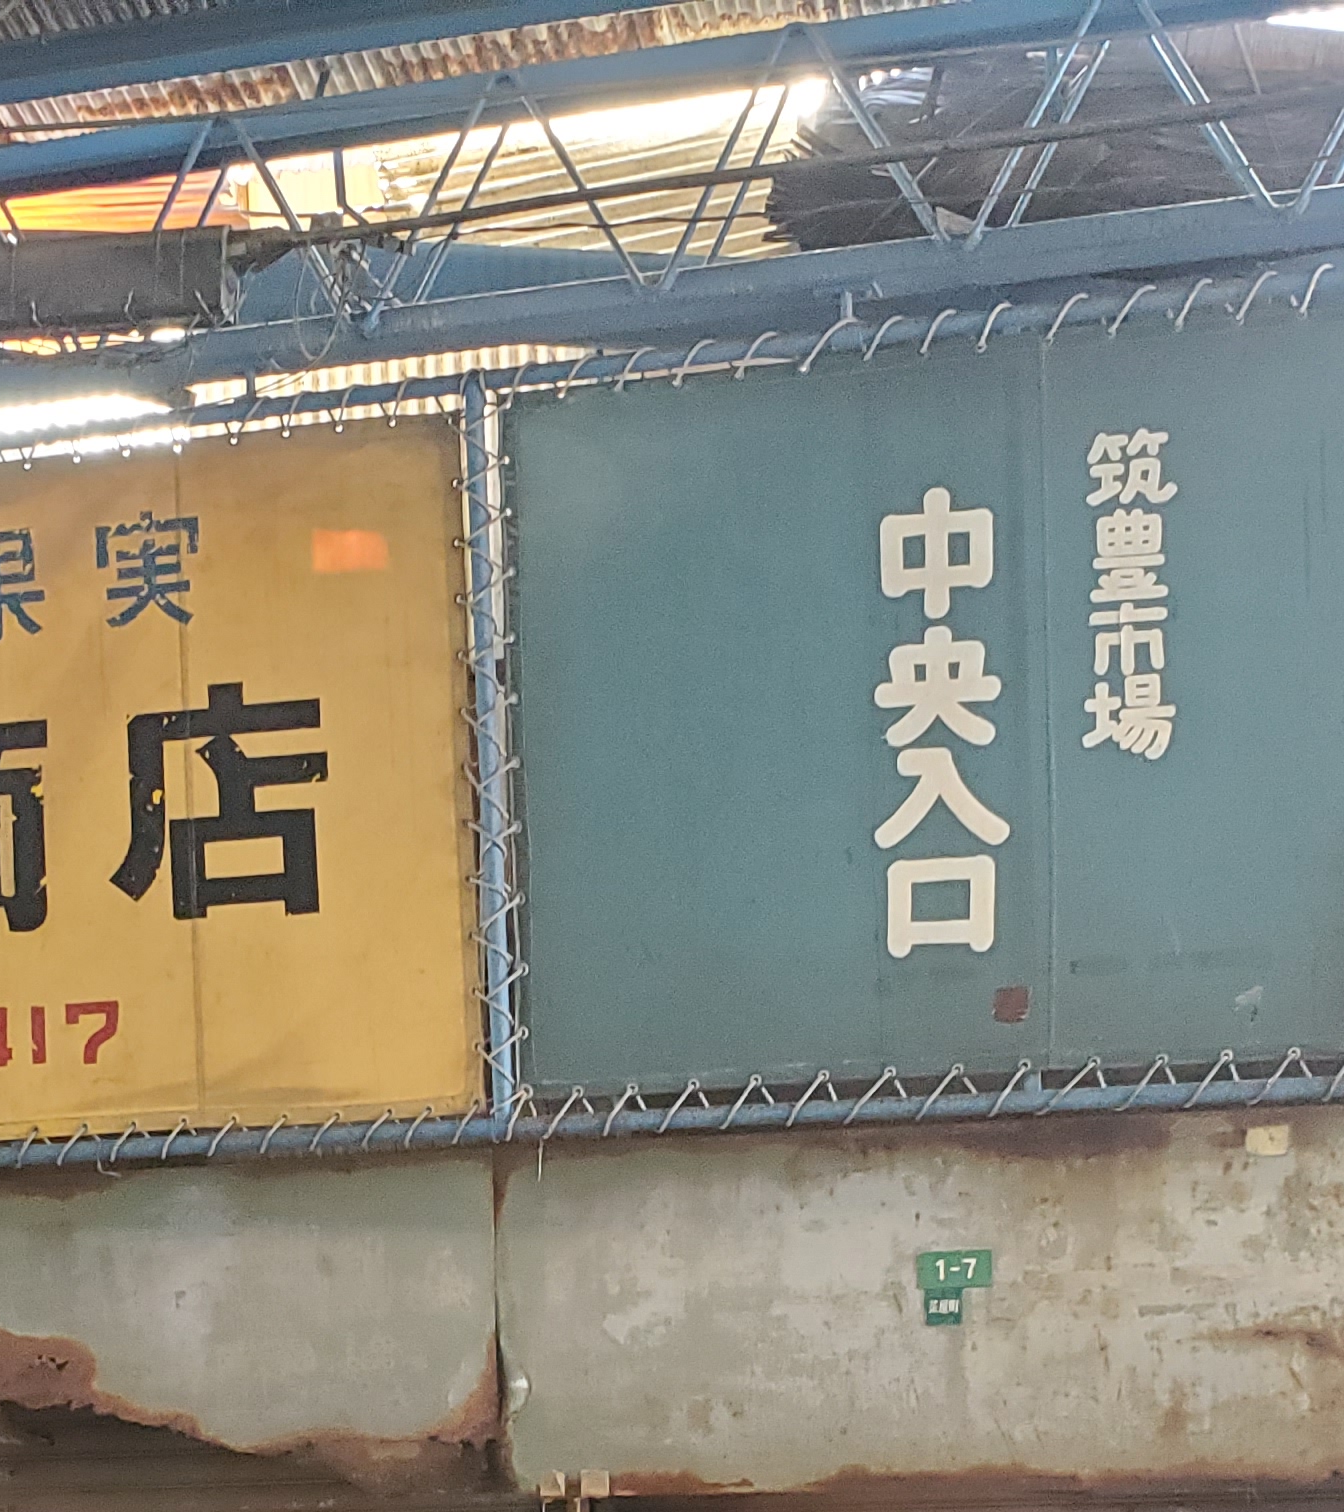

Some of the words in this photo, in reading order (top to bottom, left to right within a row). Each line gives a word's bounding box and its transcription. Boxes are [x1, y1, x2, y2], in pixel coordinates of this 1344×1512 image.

[874, 487, 1010, 958] 中央入口
[1081, 428, 1177, 760] 筑豊市場
[935, 1258, 977, 1281] 1-7
